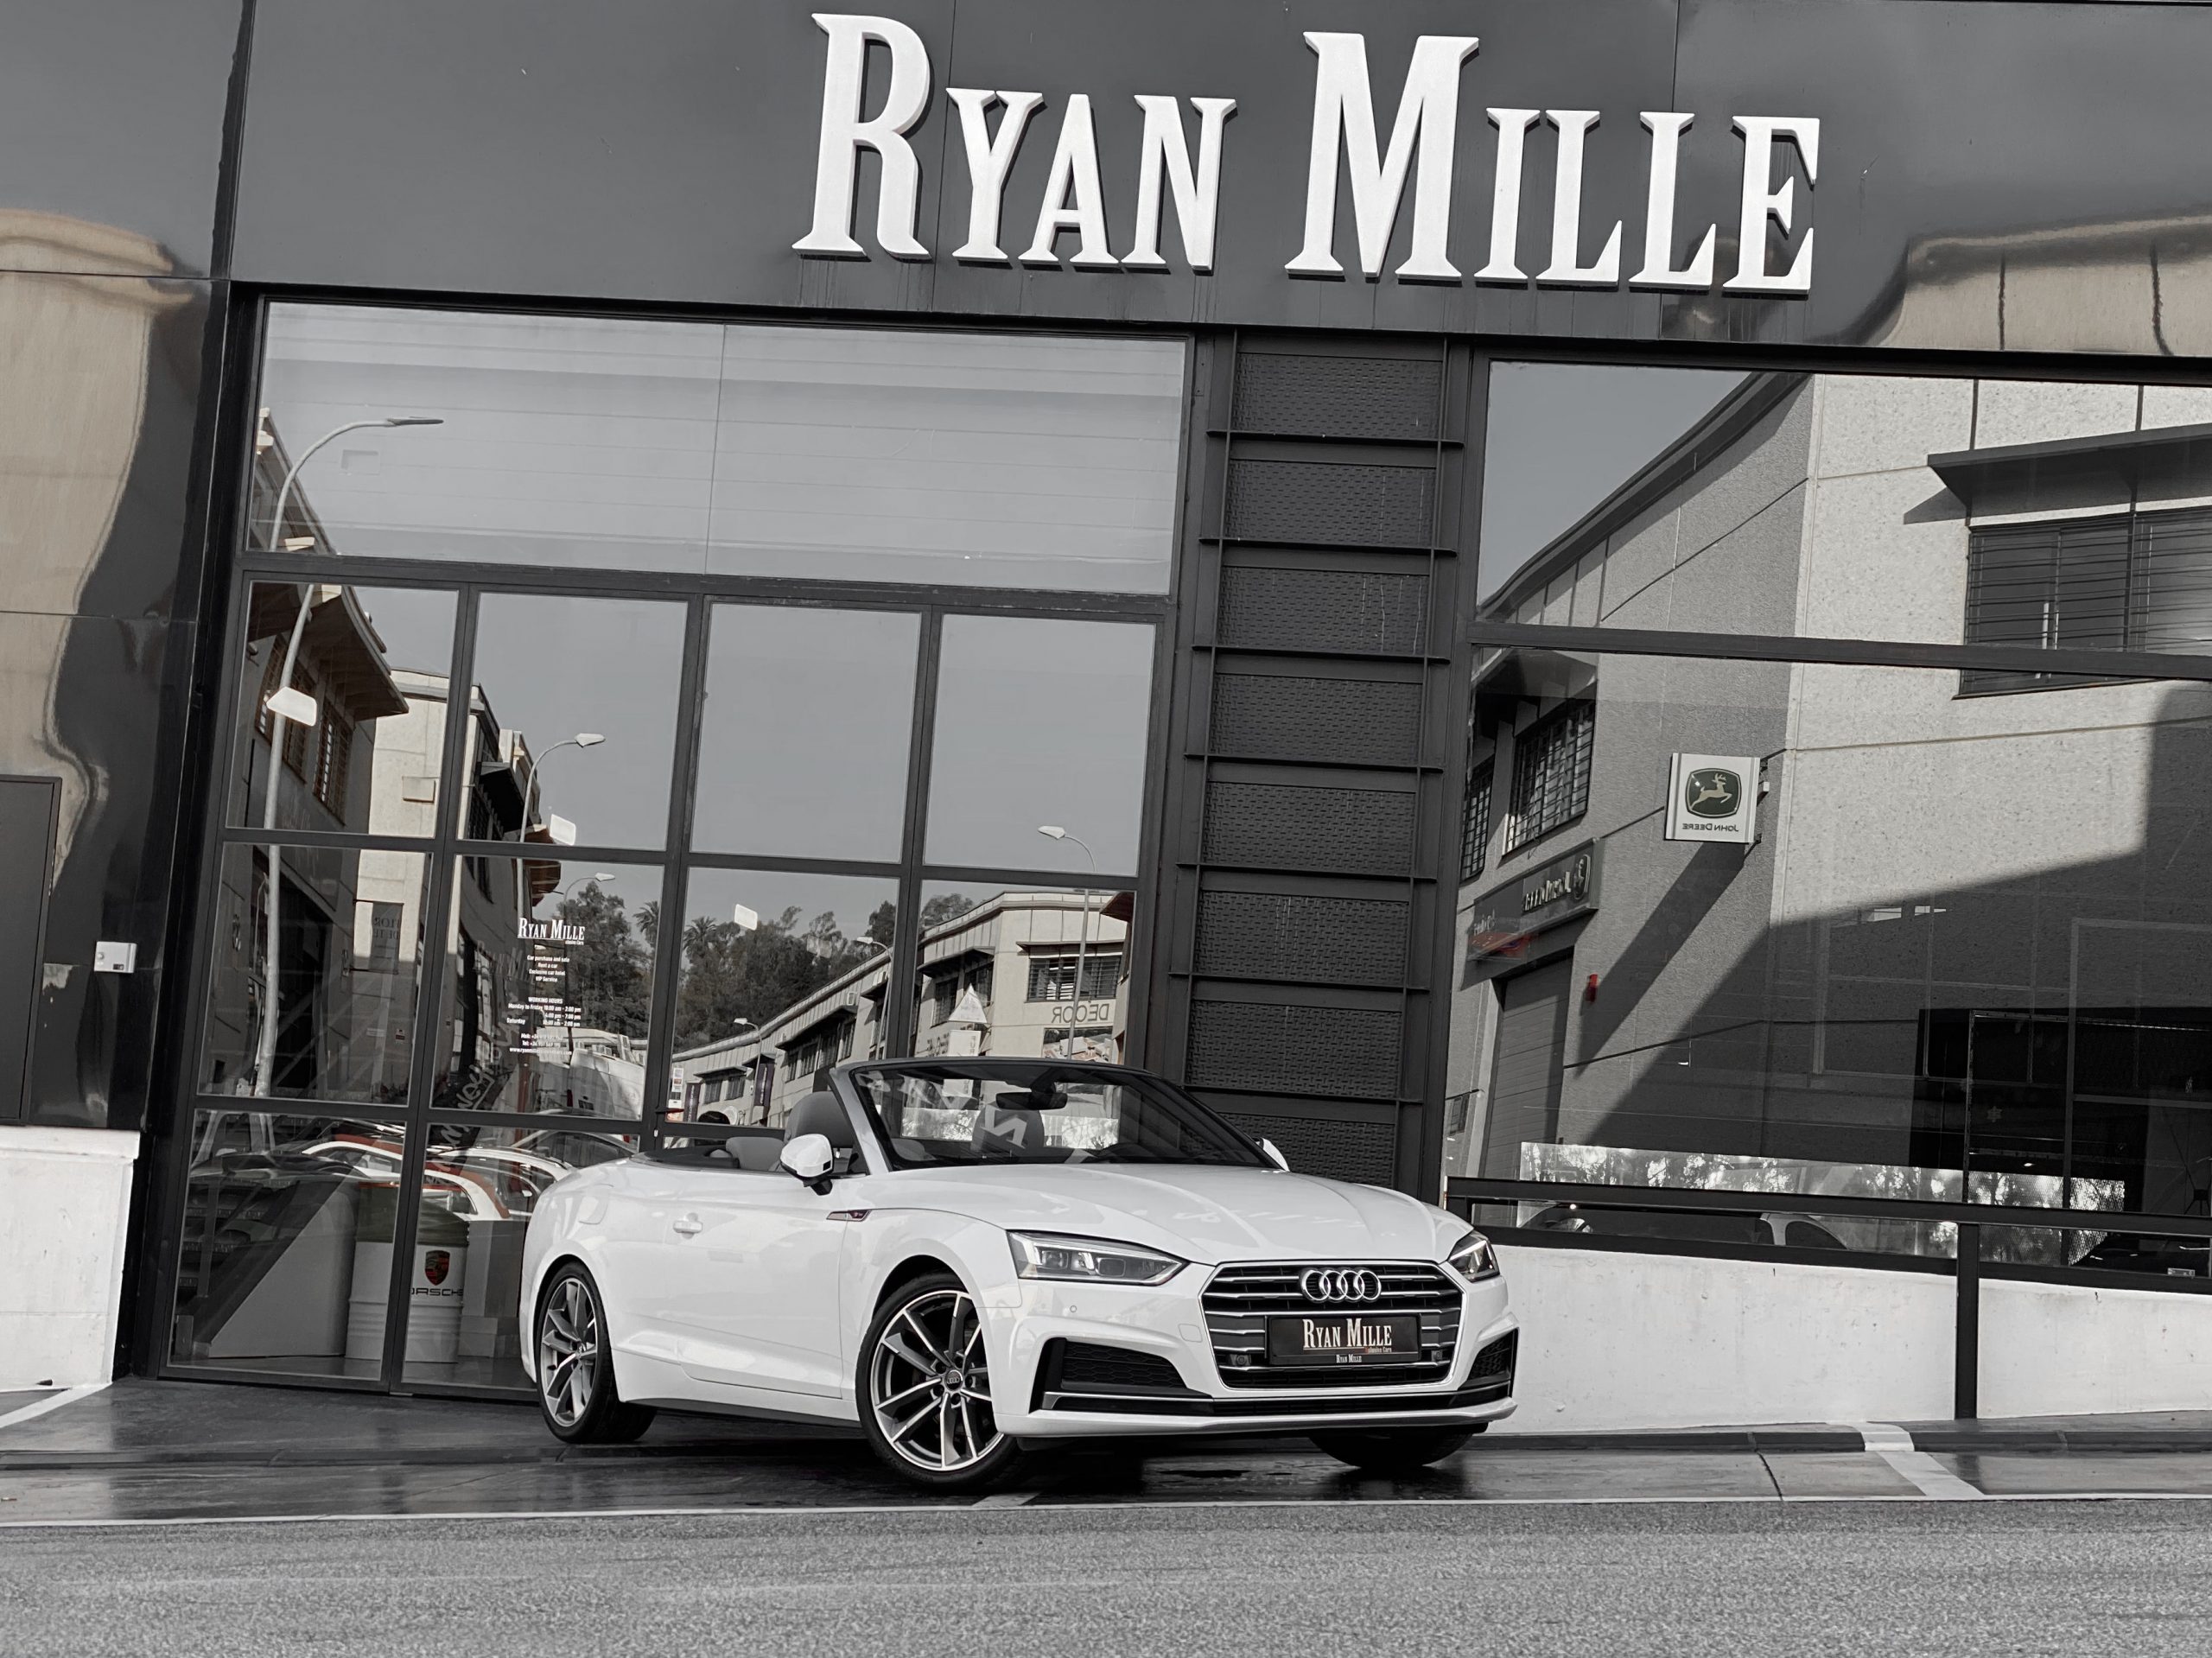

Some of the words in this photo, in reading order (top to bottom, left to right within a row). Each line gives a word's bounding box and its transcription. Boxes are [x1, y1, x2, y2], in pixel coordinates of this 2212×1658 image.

[791, 13, 1236, 270] RYAN
[1284, 31, 1820, 294] MILLE
[518, 918, 547, 937] RYAN
[550, 919, 585, 940] MILLE
[1302, 1318, 1341, 1348] RYAN
[1346, 1318, 1392, 1347] MILLE
